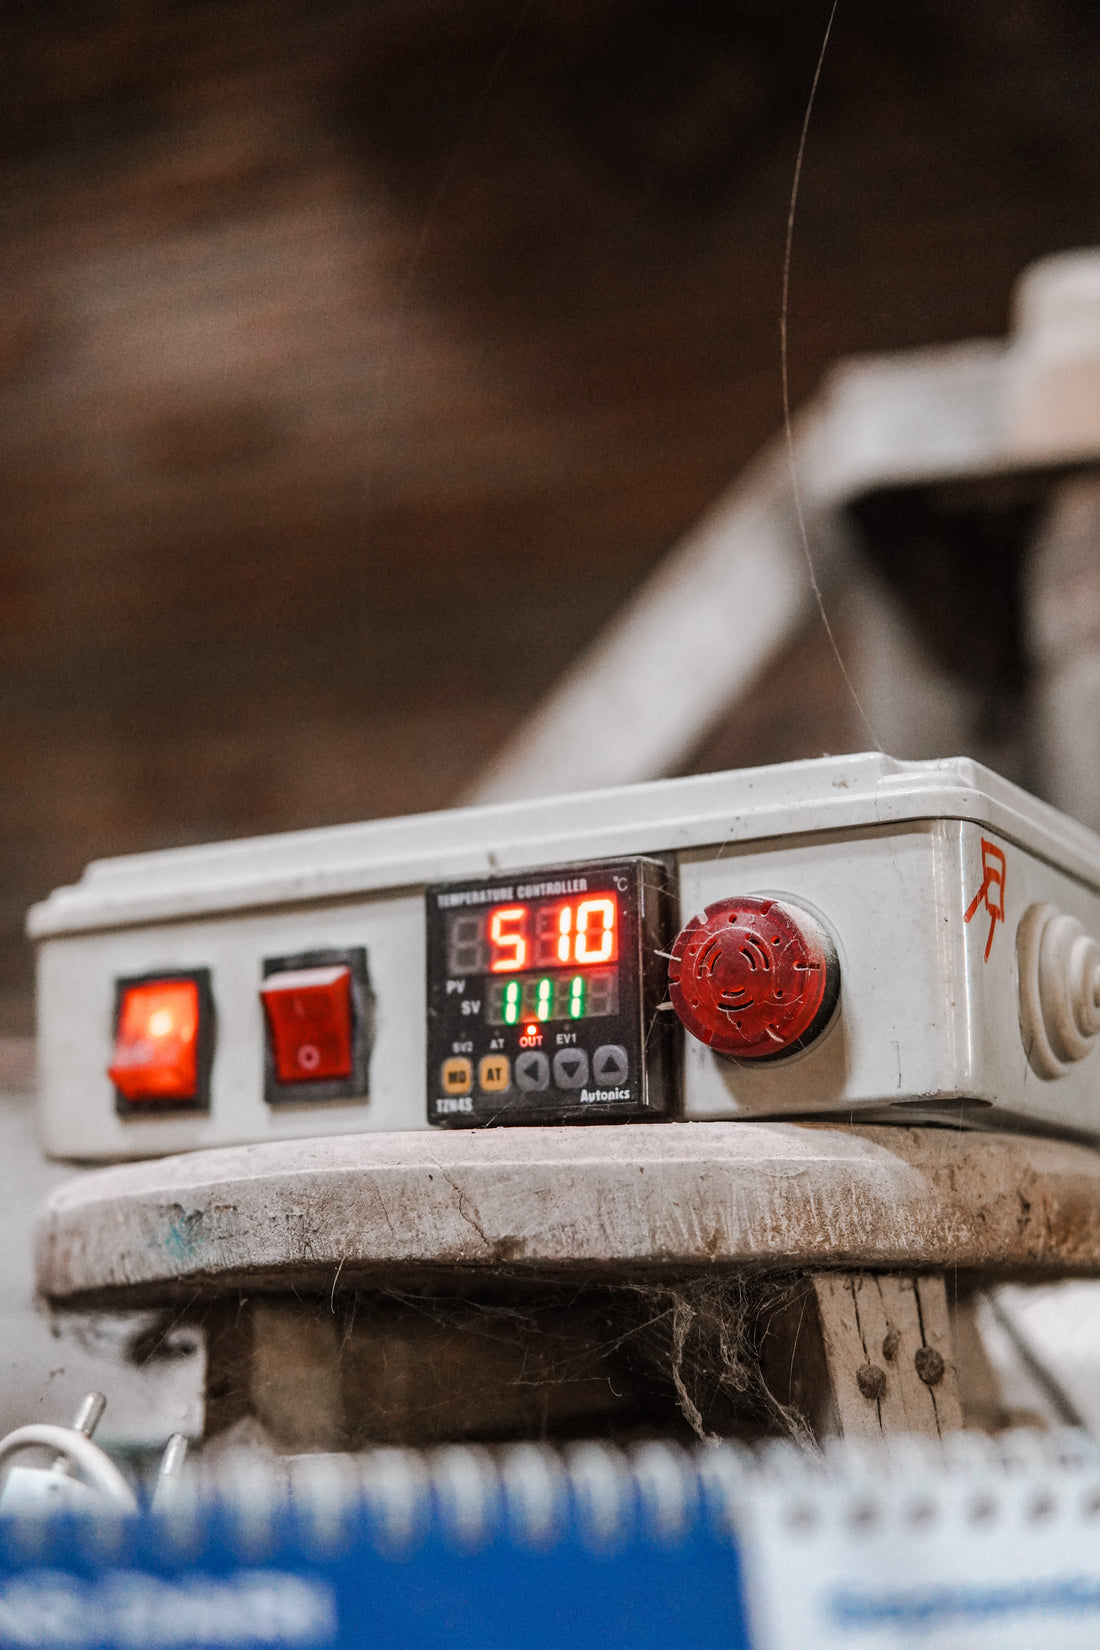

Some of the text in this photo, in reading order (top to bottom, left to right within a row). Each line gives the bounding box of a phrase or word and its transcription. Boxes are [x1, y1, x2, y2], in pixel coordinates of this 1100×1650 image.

[437, 878, 588, 908] TEMPERATURE CONTROLLER
[445, 979, 467, 995] PV
[460, 1000, 481, 1016] SV
[503, 975, 585, 1026] 111
[489, 1038, 505, 1050] AT
[519, 1035, 544, 1048] OUT
[556, 1033, 577, 1045] EV1
[486, 1067, 502, 1082] AT
[580, 1086, 631, 1103] Autonics
